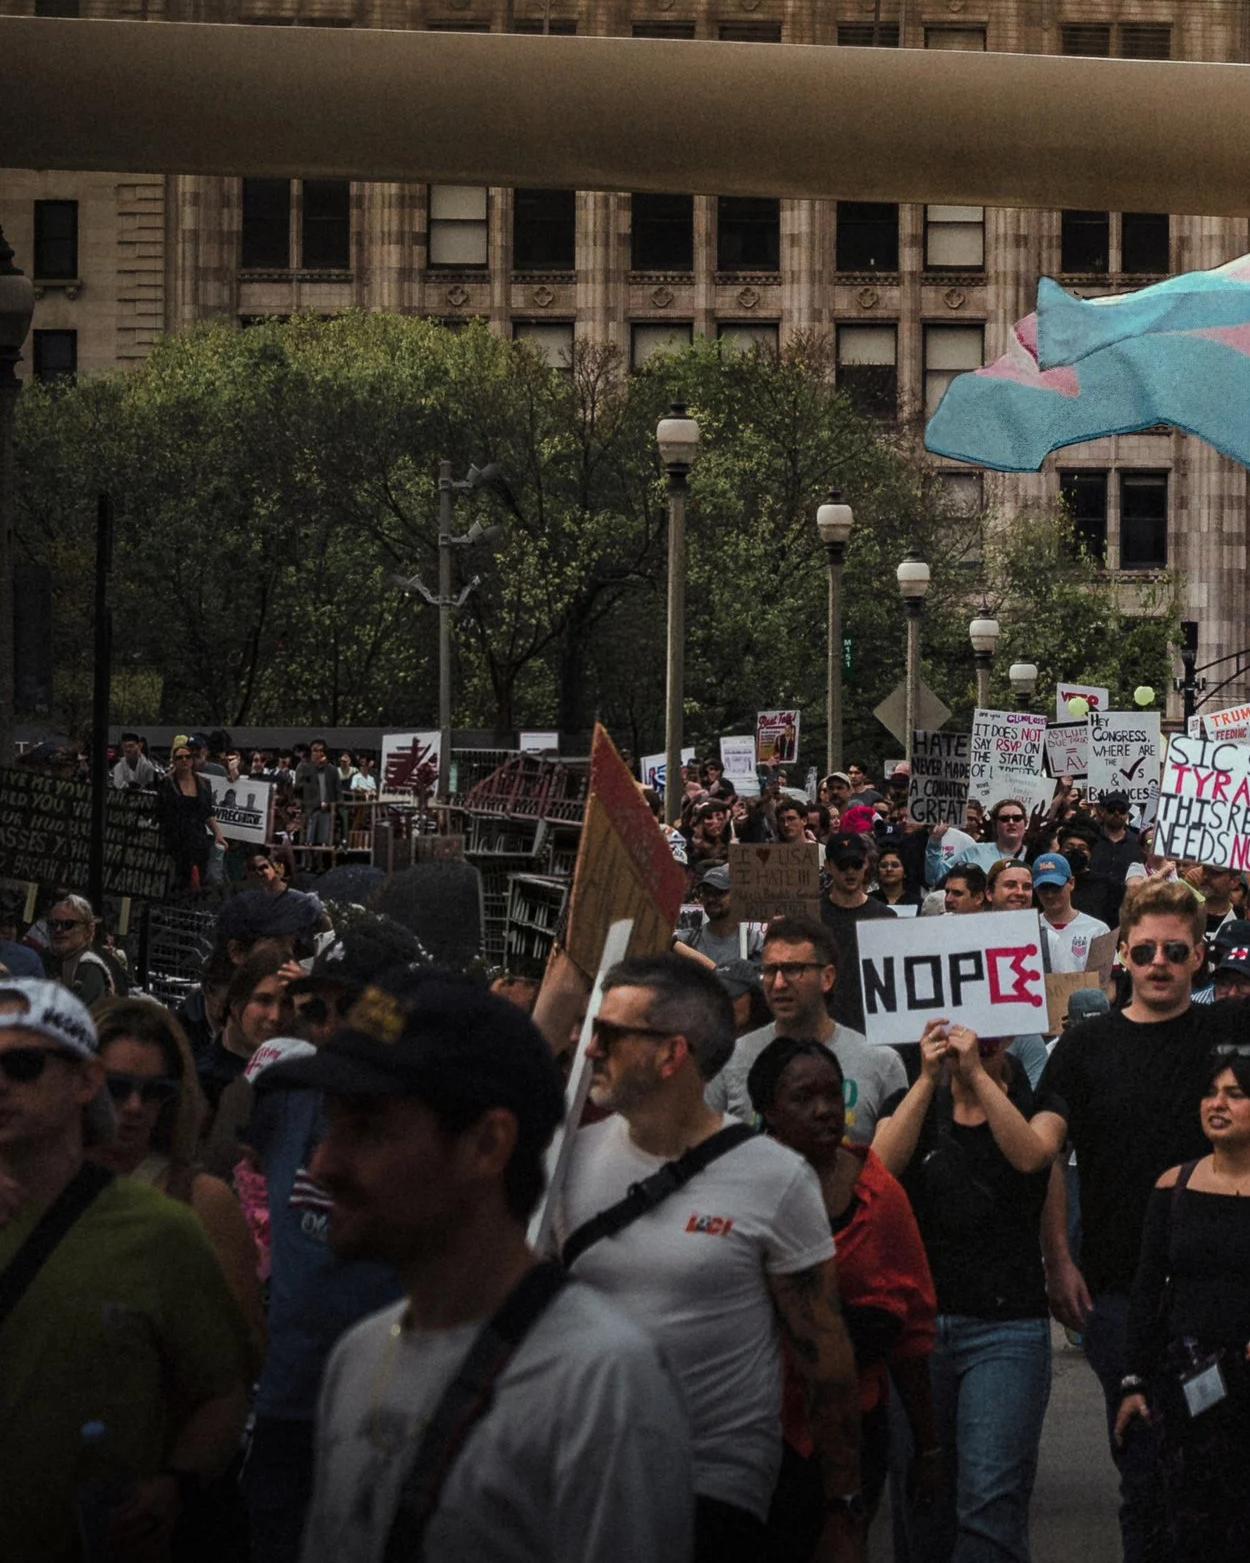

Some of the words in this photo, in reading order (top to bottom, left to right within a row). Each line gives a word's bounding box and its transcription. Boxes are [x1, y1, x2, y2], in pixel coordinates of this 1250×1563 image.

[1090, 714, 1109, 727] HEY
[974, 723, 990, 736] IT
[992, 724, 1018, 739] DOES
[1021, 727, 1044, 742] NOT
[1092, 727, 1151, 743] CONGRESS,
[912, 731, 968, 757] HATE
[973, 738, 992, 750] SAY
[996, 738, 1022, 752] RSVP
[1024, 741, 1040, 754] ON
[1093, 745, 1130, 757] WHERE
[1138, 744, 1156, 756] ARE
[972, 751, 991, 763] THE
[999, 752, 1035, 767] STATUE
[1104, 758, 1117, 766] THE
[1169, 736, 1239, 773] SIC
[911, 757, 942, 776] NEVER
[944, 760, 971, 779] MADE
[971, 763, 986, 777] OF
[910, 779, 919, 796] A
[924, 779, 970, 799] COUNTRY
[910, 798, 967, 824] GREAT
[1160, 792, 1227, 829] THIS
[1154, 820, 1230, 865] NEEDS
[735, 848, 750, 865] I
[778, 848, 814, 865] USA
[735, 869, 750, 884] I
